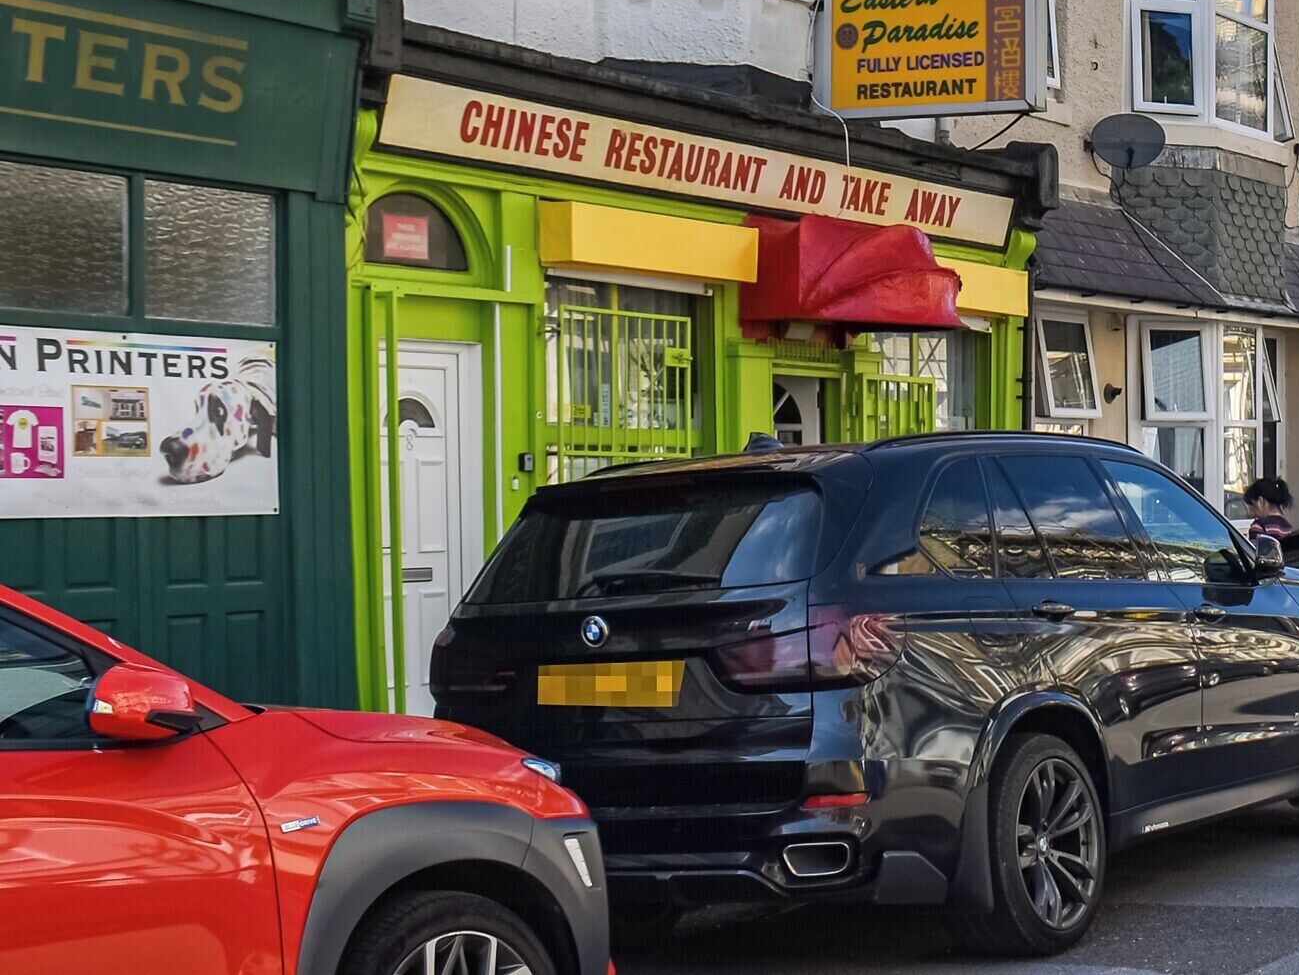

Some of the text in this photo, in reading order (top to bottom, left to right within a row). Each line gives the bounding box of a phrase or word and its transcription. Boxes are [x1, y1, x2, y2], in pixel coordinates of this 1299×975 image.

[861, 13, 979, 53] Paradise
[857, 51, 985, 74] FULLY LICENSED
[857, 78, 977, 100] RESTAURANT
[460, 100, 962, 228] CHINESE RESTAURANT AND TAKE AWAY
[36, 337, 229, 380] PRINTERS
